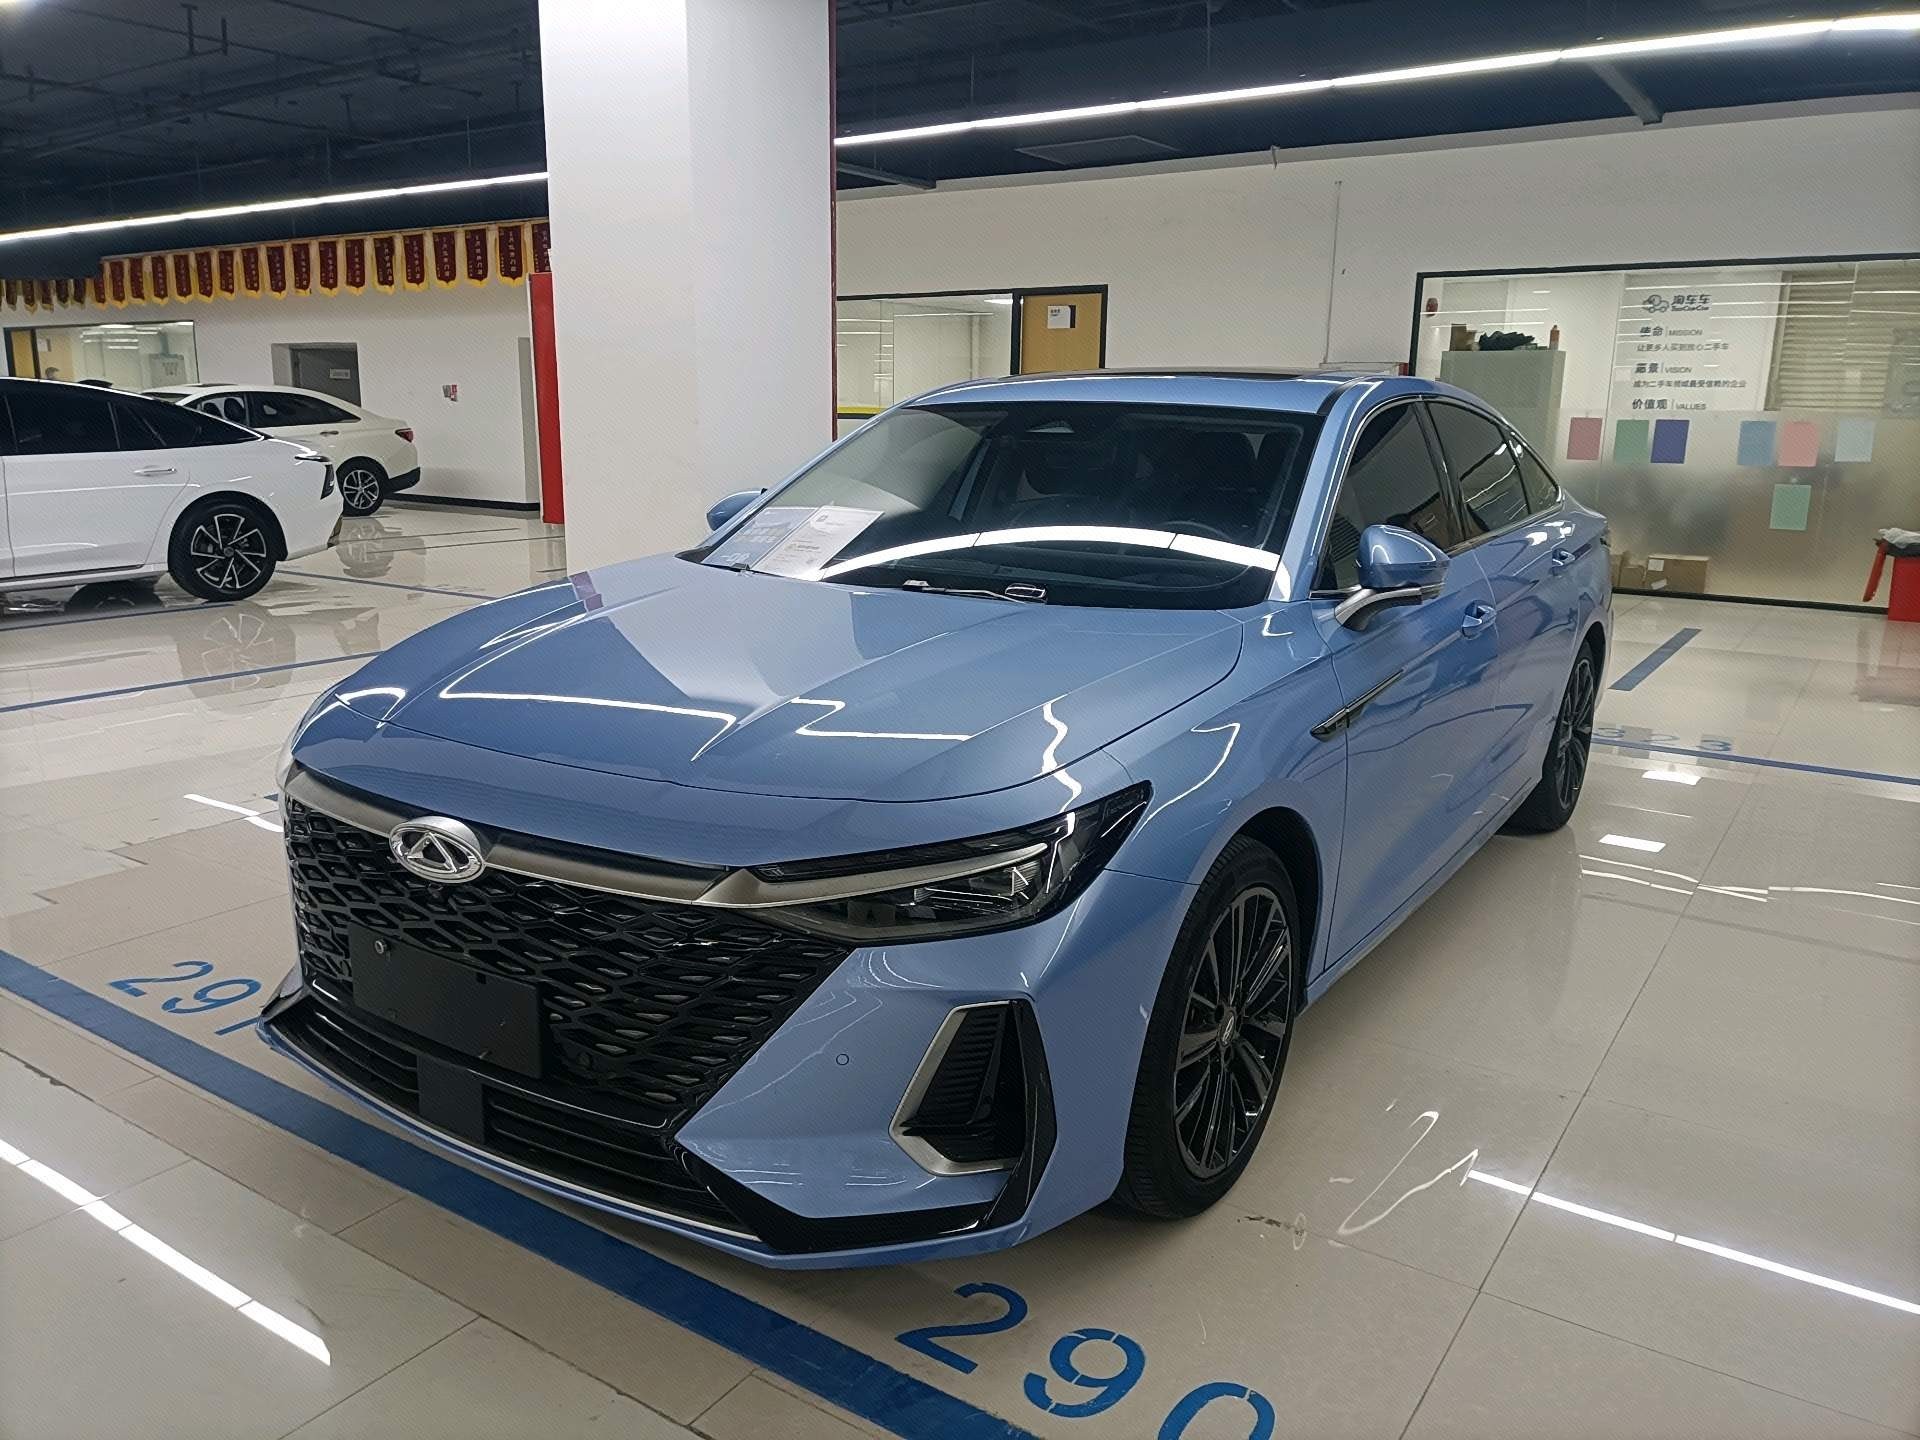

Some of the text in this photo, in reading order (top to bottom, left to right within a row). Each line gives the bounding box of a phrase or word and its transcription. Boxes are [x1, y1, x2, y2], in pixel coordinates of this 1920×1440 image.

[1665, 366, 1692, 374] VISION
[1632, 398, 1707, 411] 价值观 VALUES
[894, 1282, 1276, 1440] 290
